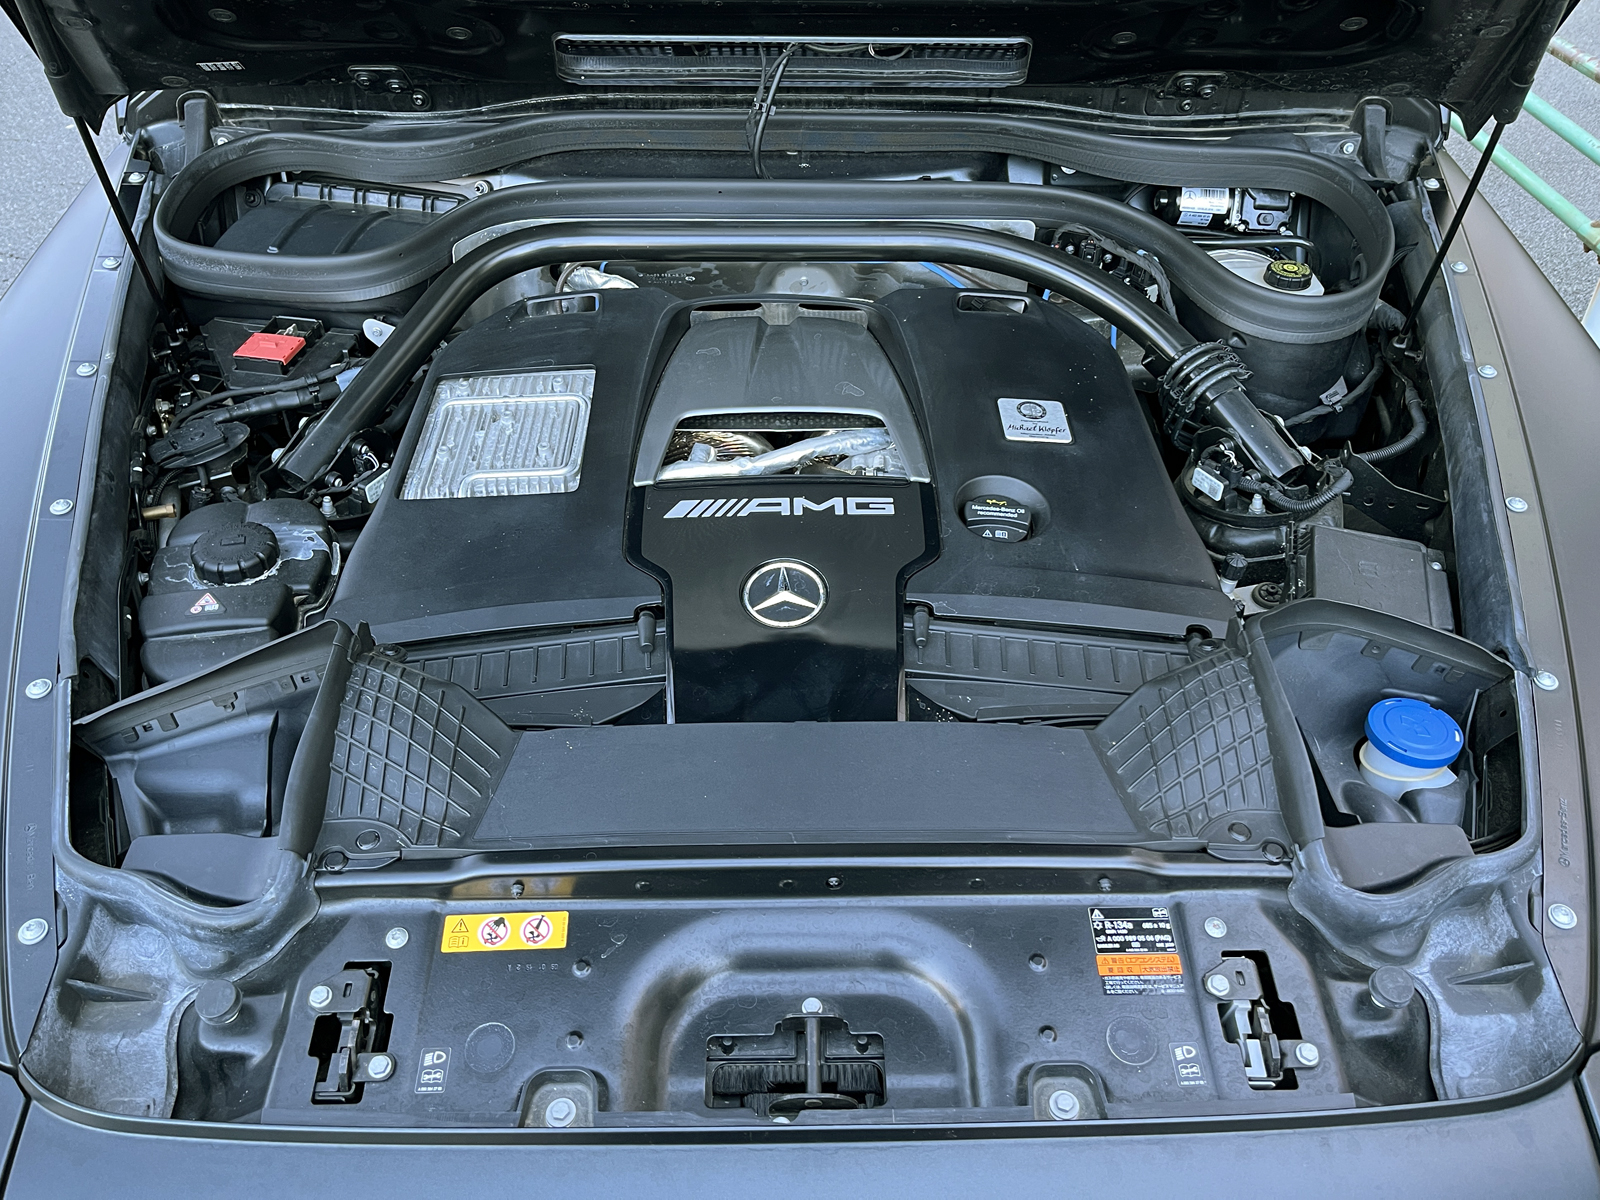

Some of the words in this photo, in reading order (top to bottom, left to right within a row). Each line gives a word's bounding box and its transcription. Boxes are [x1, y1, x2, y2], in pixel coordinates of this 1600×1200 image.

[737, 496, 895, 516] AMG
[971, 504, 1016, 513] Mercedes-Benz
[977, 510, 1018, 518] recommended
[1104, 920, 1134, 929] R-134a
